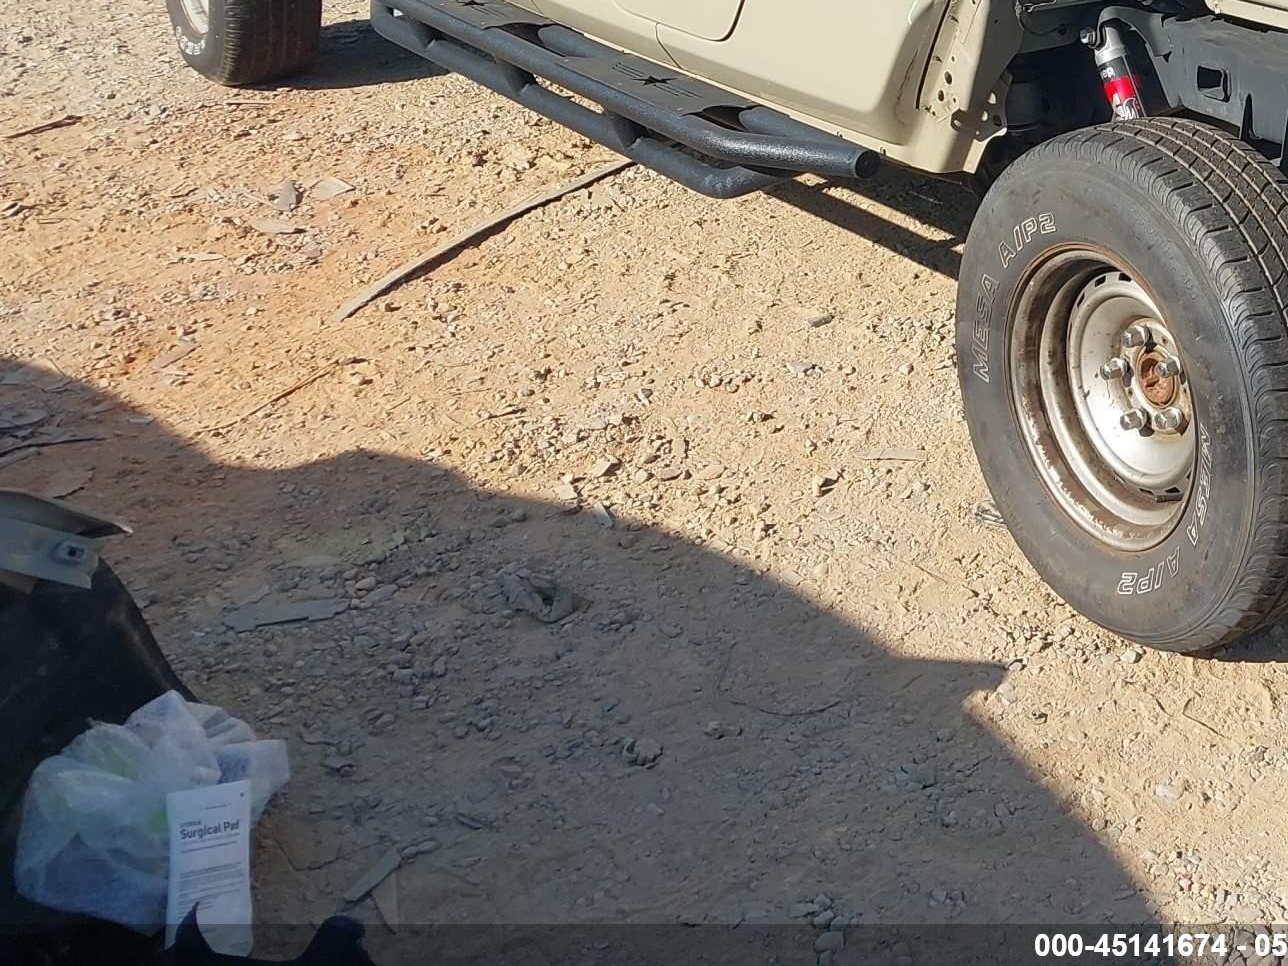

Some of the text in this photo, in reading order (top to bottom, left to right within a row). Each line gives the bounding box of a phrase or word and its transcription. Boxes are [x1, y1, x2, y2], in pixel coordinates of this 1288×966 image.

[971, 273, 1000, 384] MESA
[1186, 424, 1213, 546] MESA
[180, 822, 222, 840] Surgical
[223, 819, 241, 832] Pad
